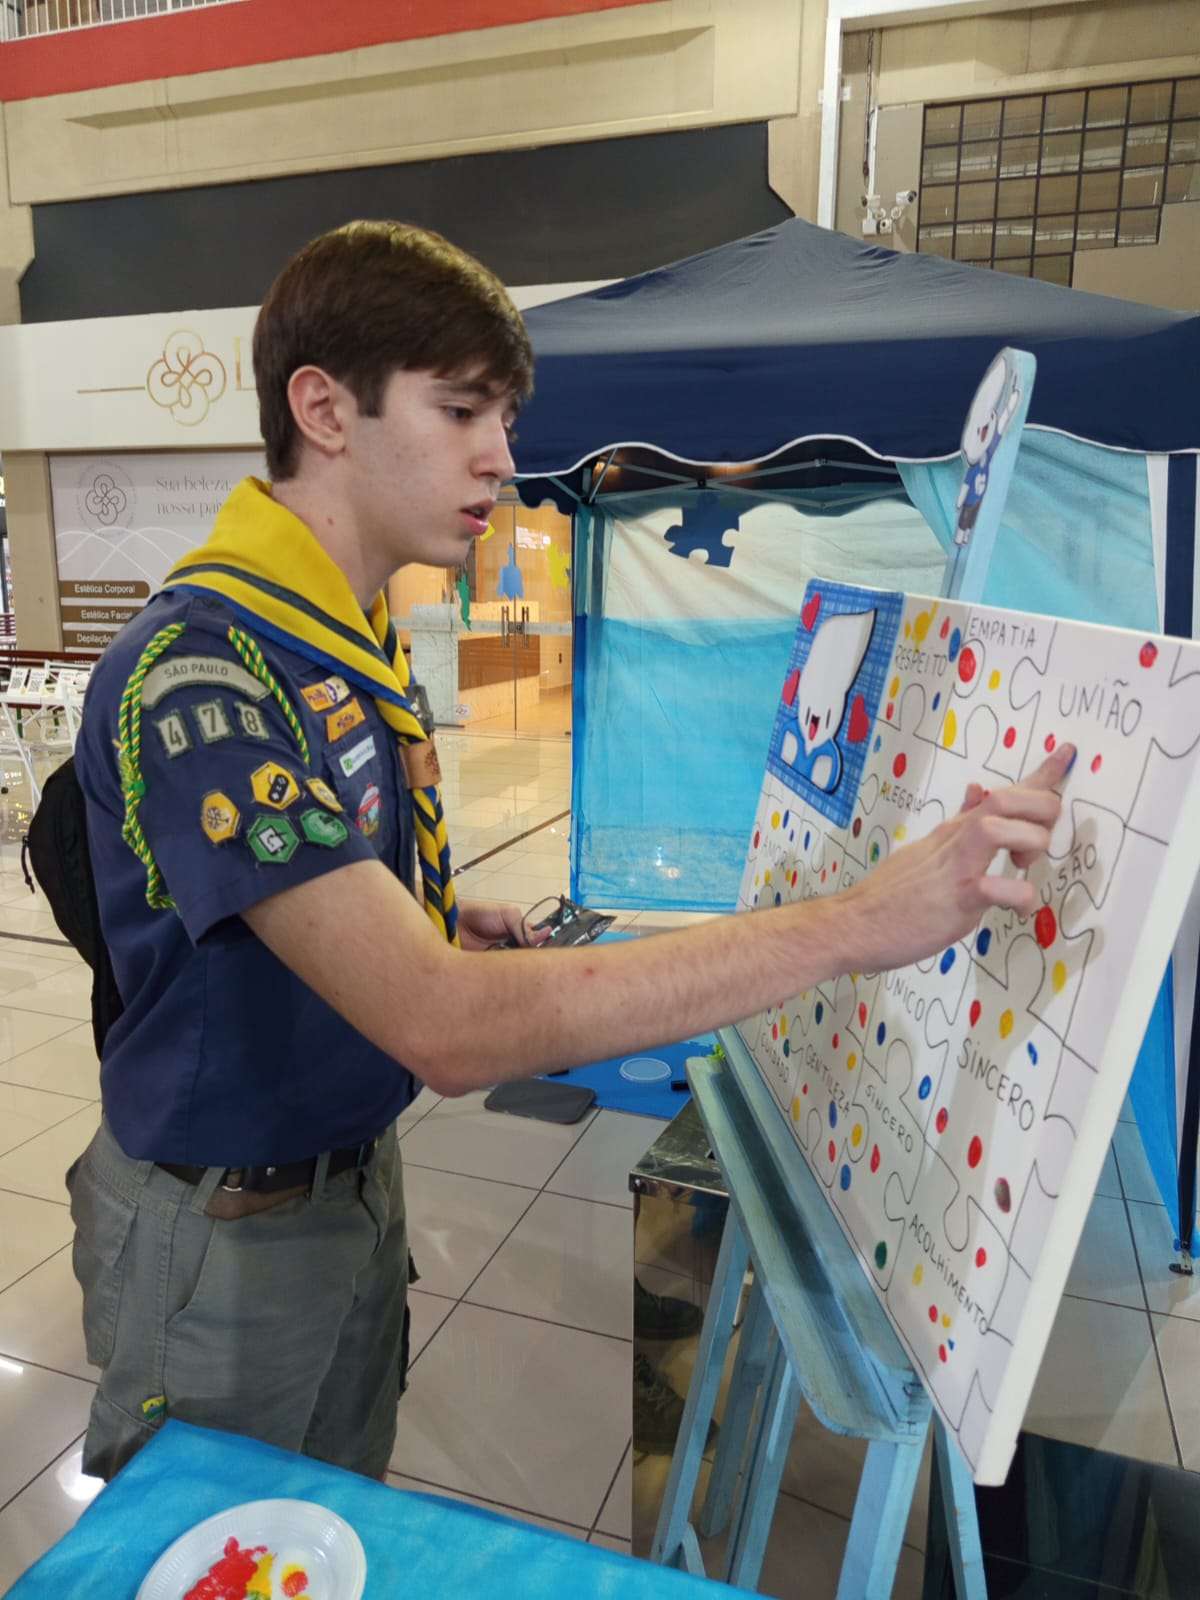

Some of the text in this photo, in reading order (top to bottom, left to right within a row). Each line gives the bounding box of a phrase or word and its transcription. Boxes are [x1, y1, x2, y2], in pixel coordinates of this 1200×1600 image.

[104, 583, 136, 595] Corporal
[164, 664, 229, 679] SÃO PAULO
